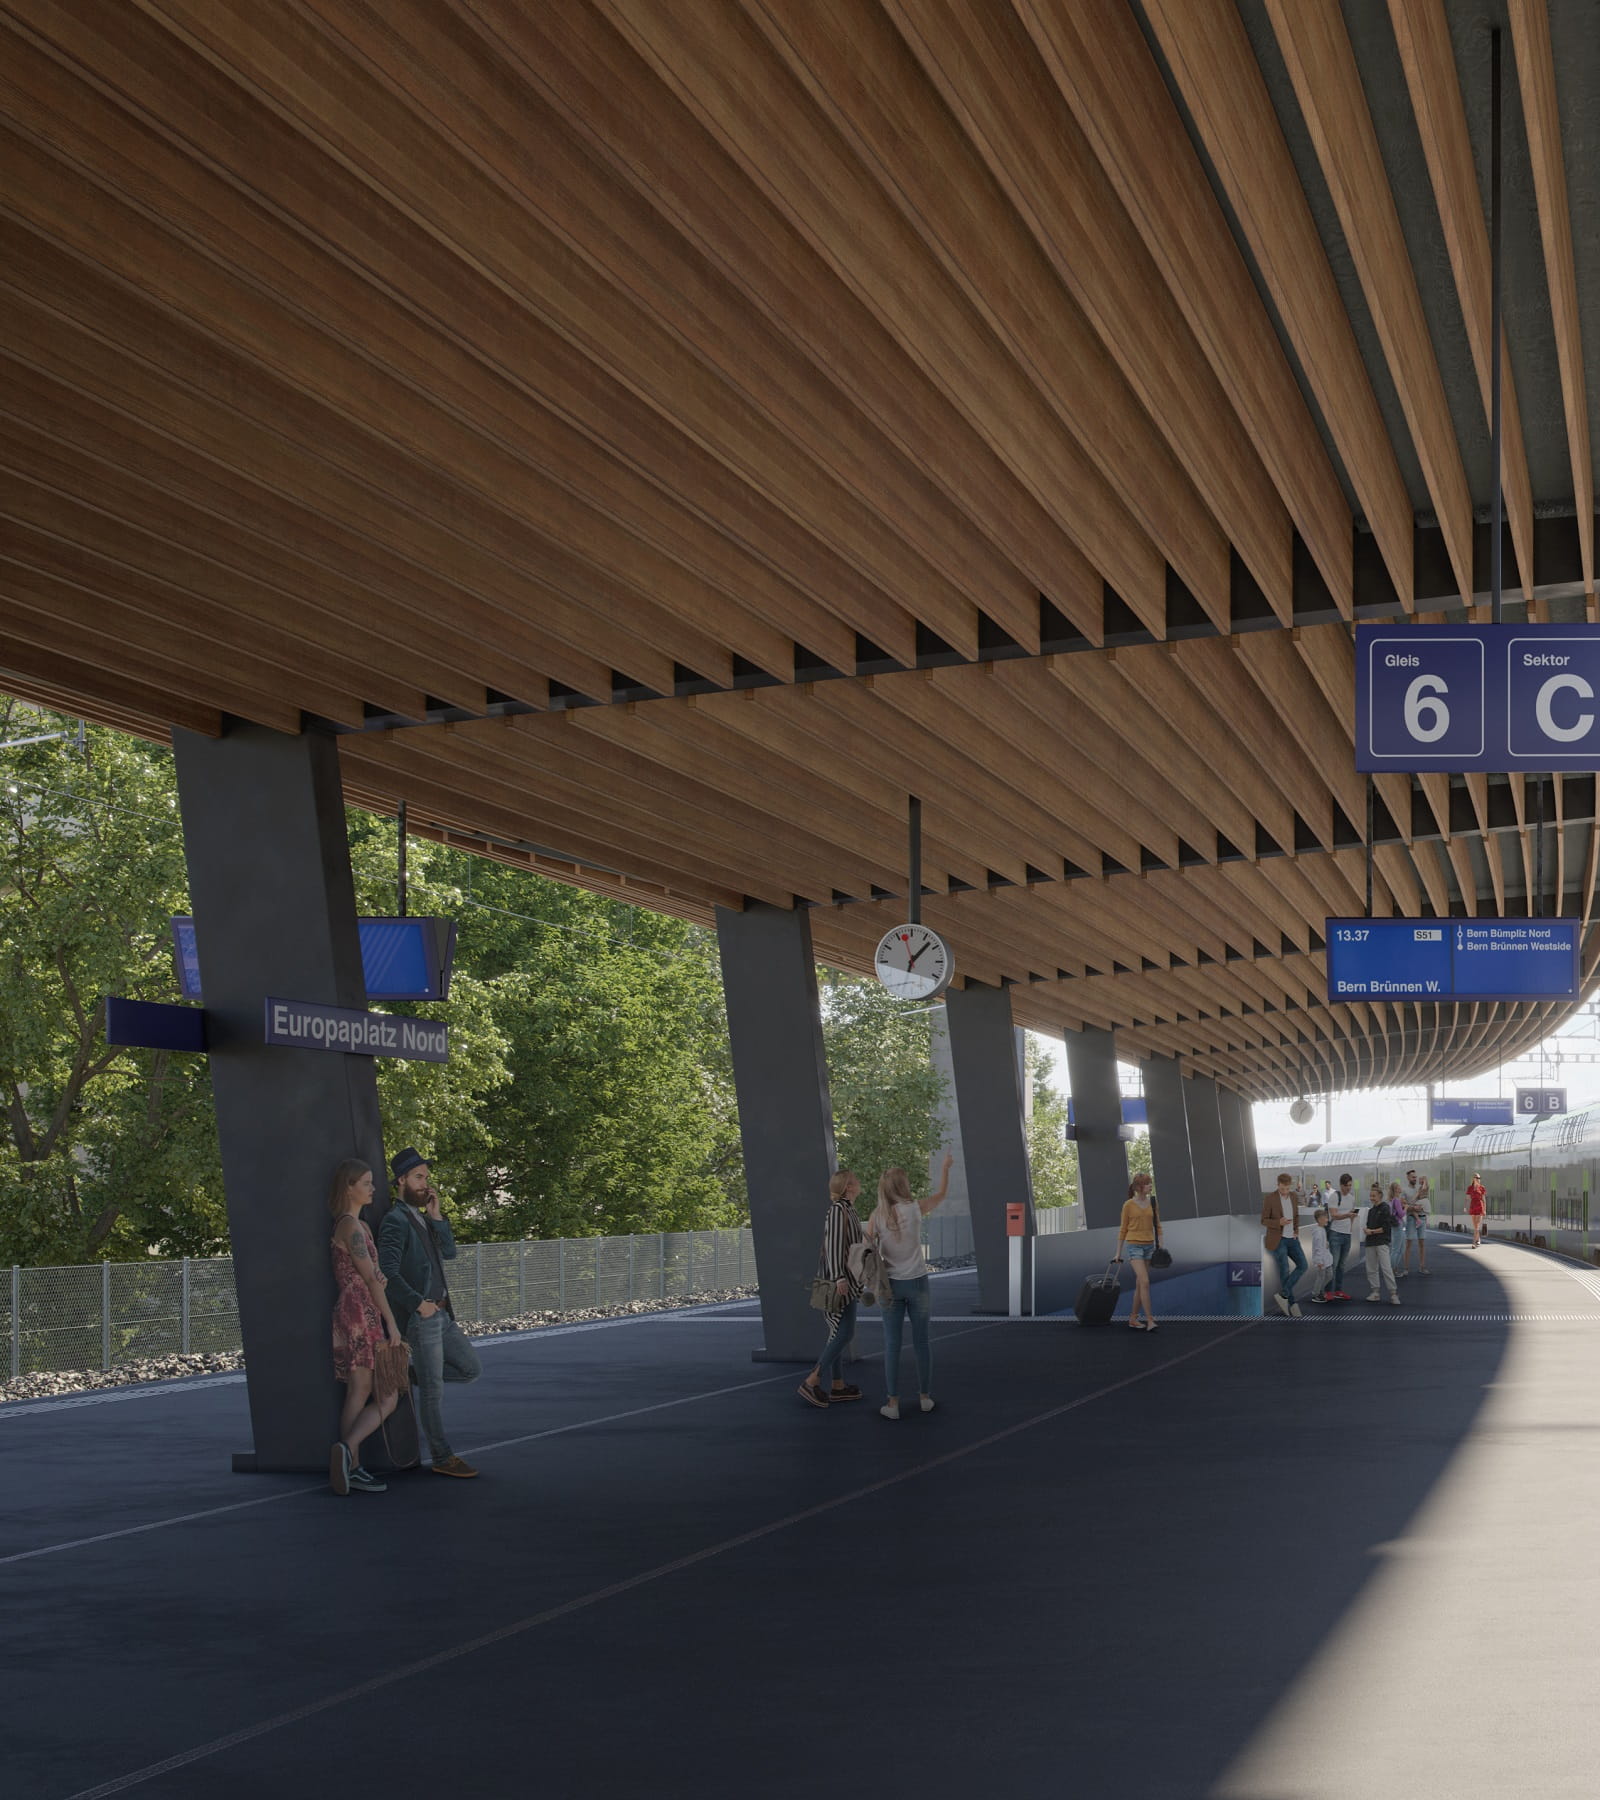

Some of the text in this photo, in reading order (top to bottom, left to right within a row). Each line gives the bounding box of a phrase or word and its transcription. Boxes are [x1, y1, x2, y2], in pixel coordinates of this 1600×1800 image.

[1385, 654, 1420, 667] Gleis
[1523, 653, 1570, 667] Sektor
[1403, 674, 1450, 743] 6
[1535, 673, 1595, 742] C
[1336, 930, 1370, 941] 13.37
[1416, 931, 1432, 940] S51
[1466, 928, 1551, 940] Bern Bümpliz Nord
[1466, 941, 1571, 951] Bern Brünnen Westside
[1337, 980, 1441, 993] Bern Brünnen W.
[274, 1005, 446, 1054] Europaplatz Nord
[1524, 1096, 1534, 1110] 6
[1549, 1096, 1560, 1110] B
